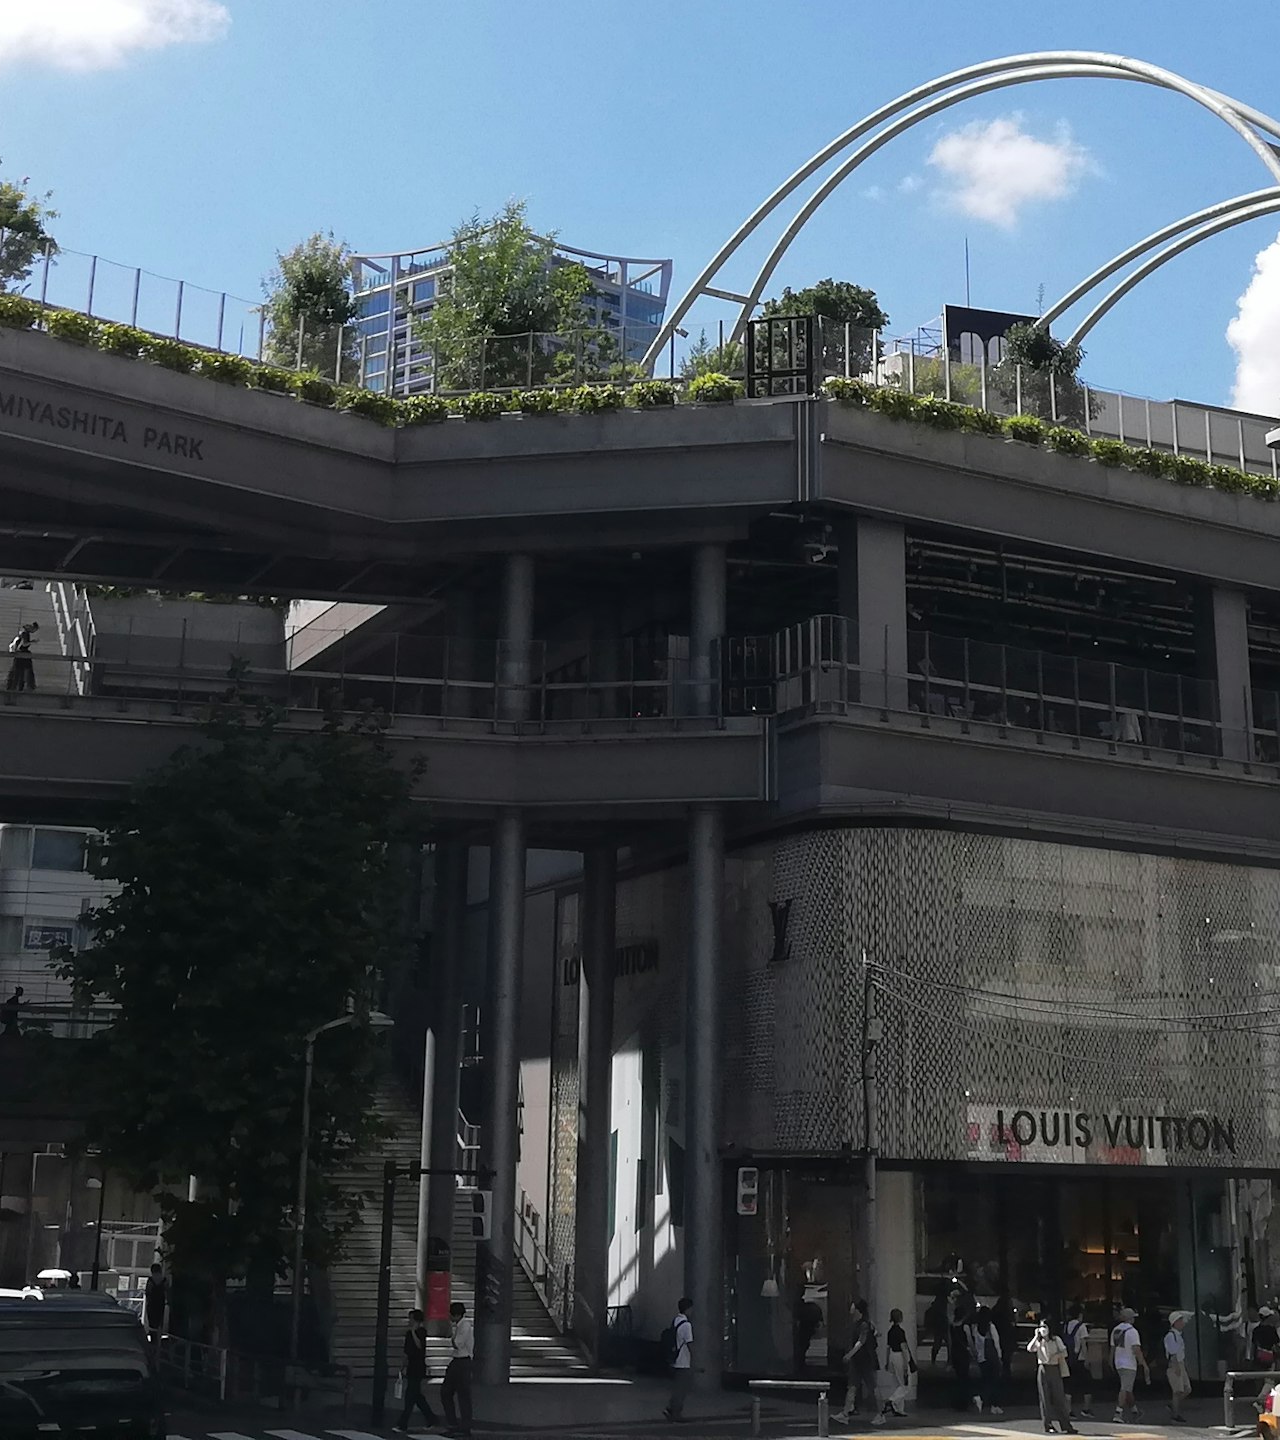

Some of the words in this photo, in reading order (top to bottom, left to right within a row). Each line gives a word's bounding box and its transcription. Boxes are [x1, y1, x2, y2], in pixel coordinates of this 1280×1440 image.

[143, 426, 203, 460] PARK
[997, 1110, 1092, 1147] LOUIS
[1103, 1114, 1236, 1154] VUITTON
